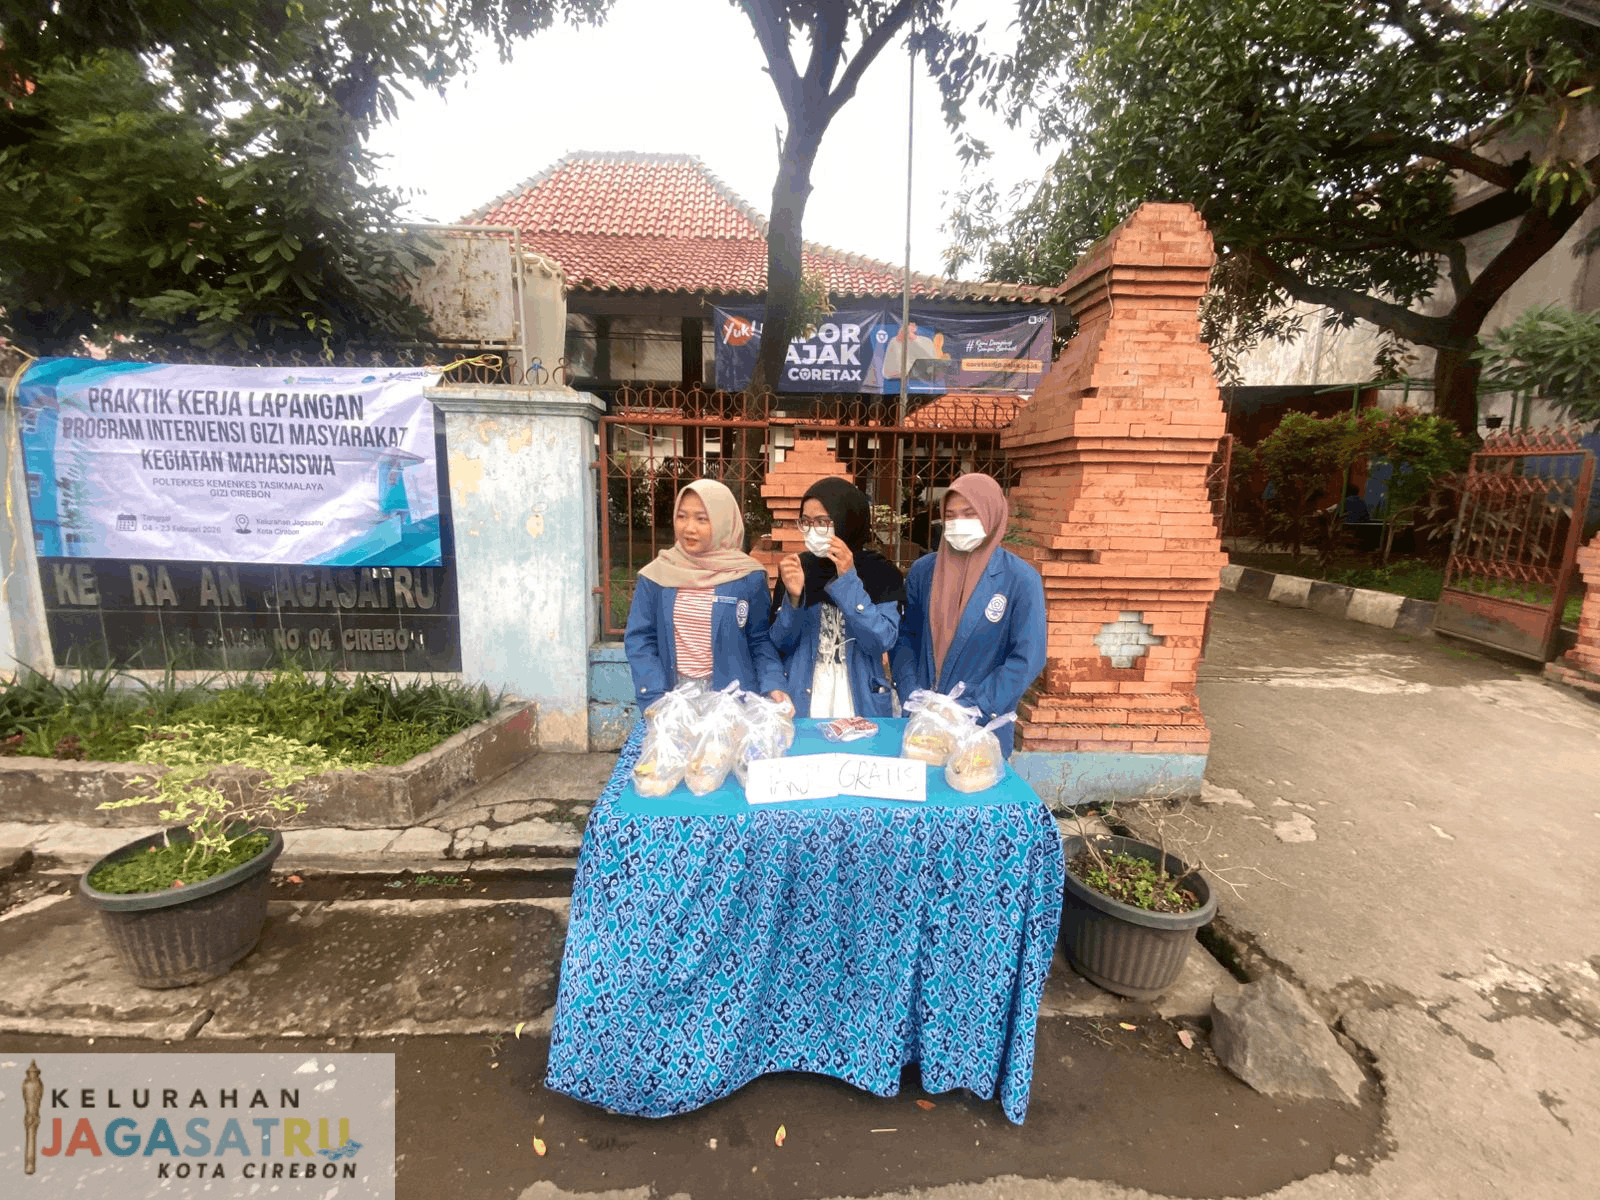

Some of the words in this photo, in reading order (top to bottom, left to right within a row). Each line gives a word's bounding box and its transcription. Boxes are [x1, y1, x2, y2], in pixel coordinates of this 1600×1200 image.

[784, 344, 861, 365] AJAK
[788, 368, 861, 381] CORETAX
[88, 388, 173, 414] PRAKTIK
[178, 390, 242, 416] KERJA
[249, 392, 364, 420] LAPANGAN
[62, 417, 144, 440] PROGRAM
[146, 419, 246, 443] INTERVENSI
[251, 422, 285, 445] GIZI
[290, 424, 408, 447] MASYARAKAT
[141, 449, 224, 472] KEGIATAN
[228, 452, 336, 476] MAHASISWA
[153, 478, 205, 487] POLTEKKES
[207, 480, 257, 489] KEMENKES
[259, 481, 324, 491] TASIKMALAYA
[210, 489, 228, 497] GIZI
[230, 490, 271, 499] CIREBON
[264, 566, 437, 609] JAGASATRU
[273, 628, 301, 651] NO
[309, 628, 334, 651] 04
